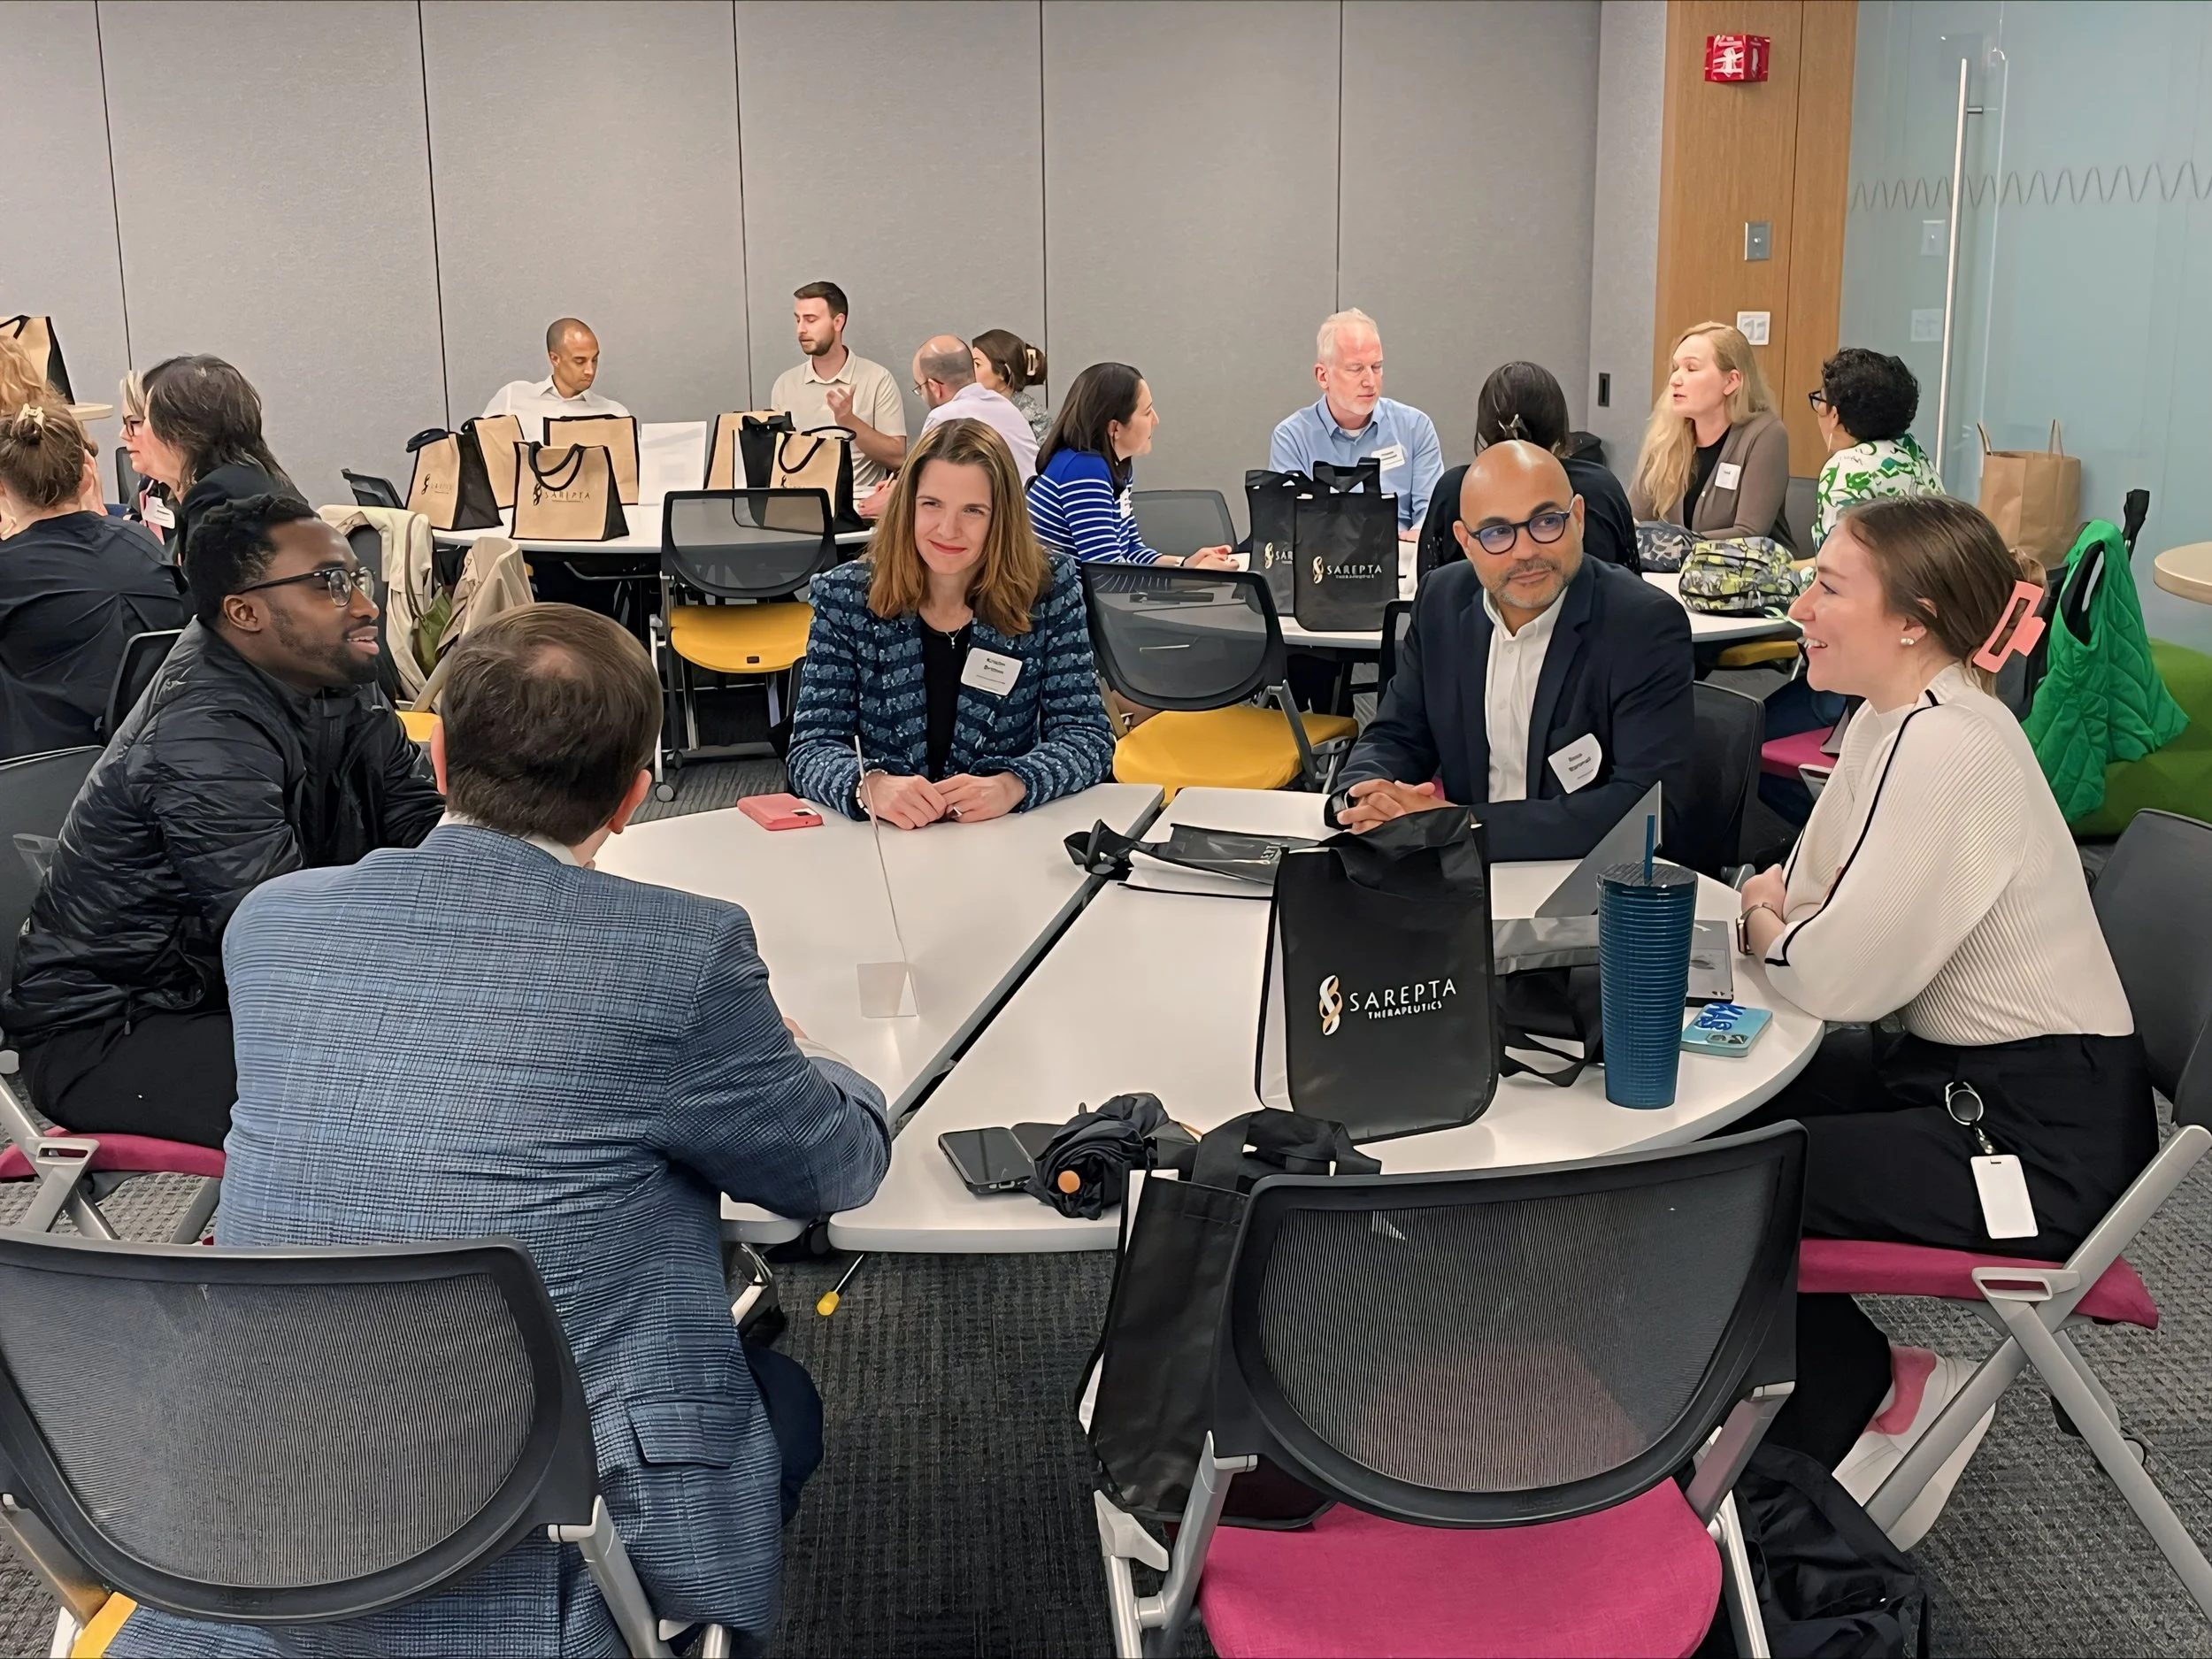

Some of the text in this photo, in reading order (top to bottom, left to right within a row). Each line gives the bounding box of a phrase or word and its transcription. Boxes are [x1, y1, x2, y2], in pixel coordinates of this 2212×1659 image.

[1327, 565, 1382, 574] SAREPTA
[1349, 978, 1456, 1012] SAREPTA
[1368, 1000, 1442, 1019] THERAPEUTICS
